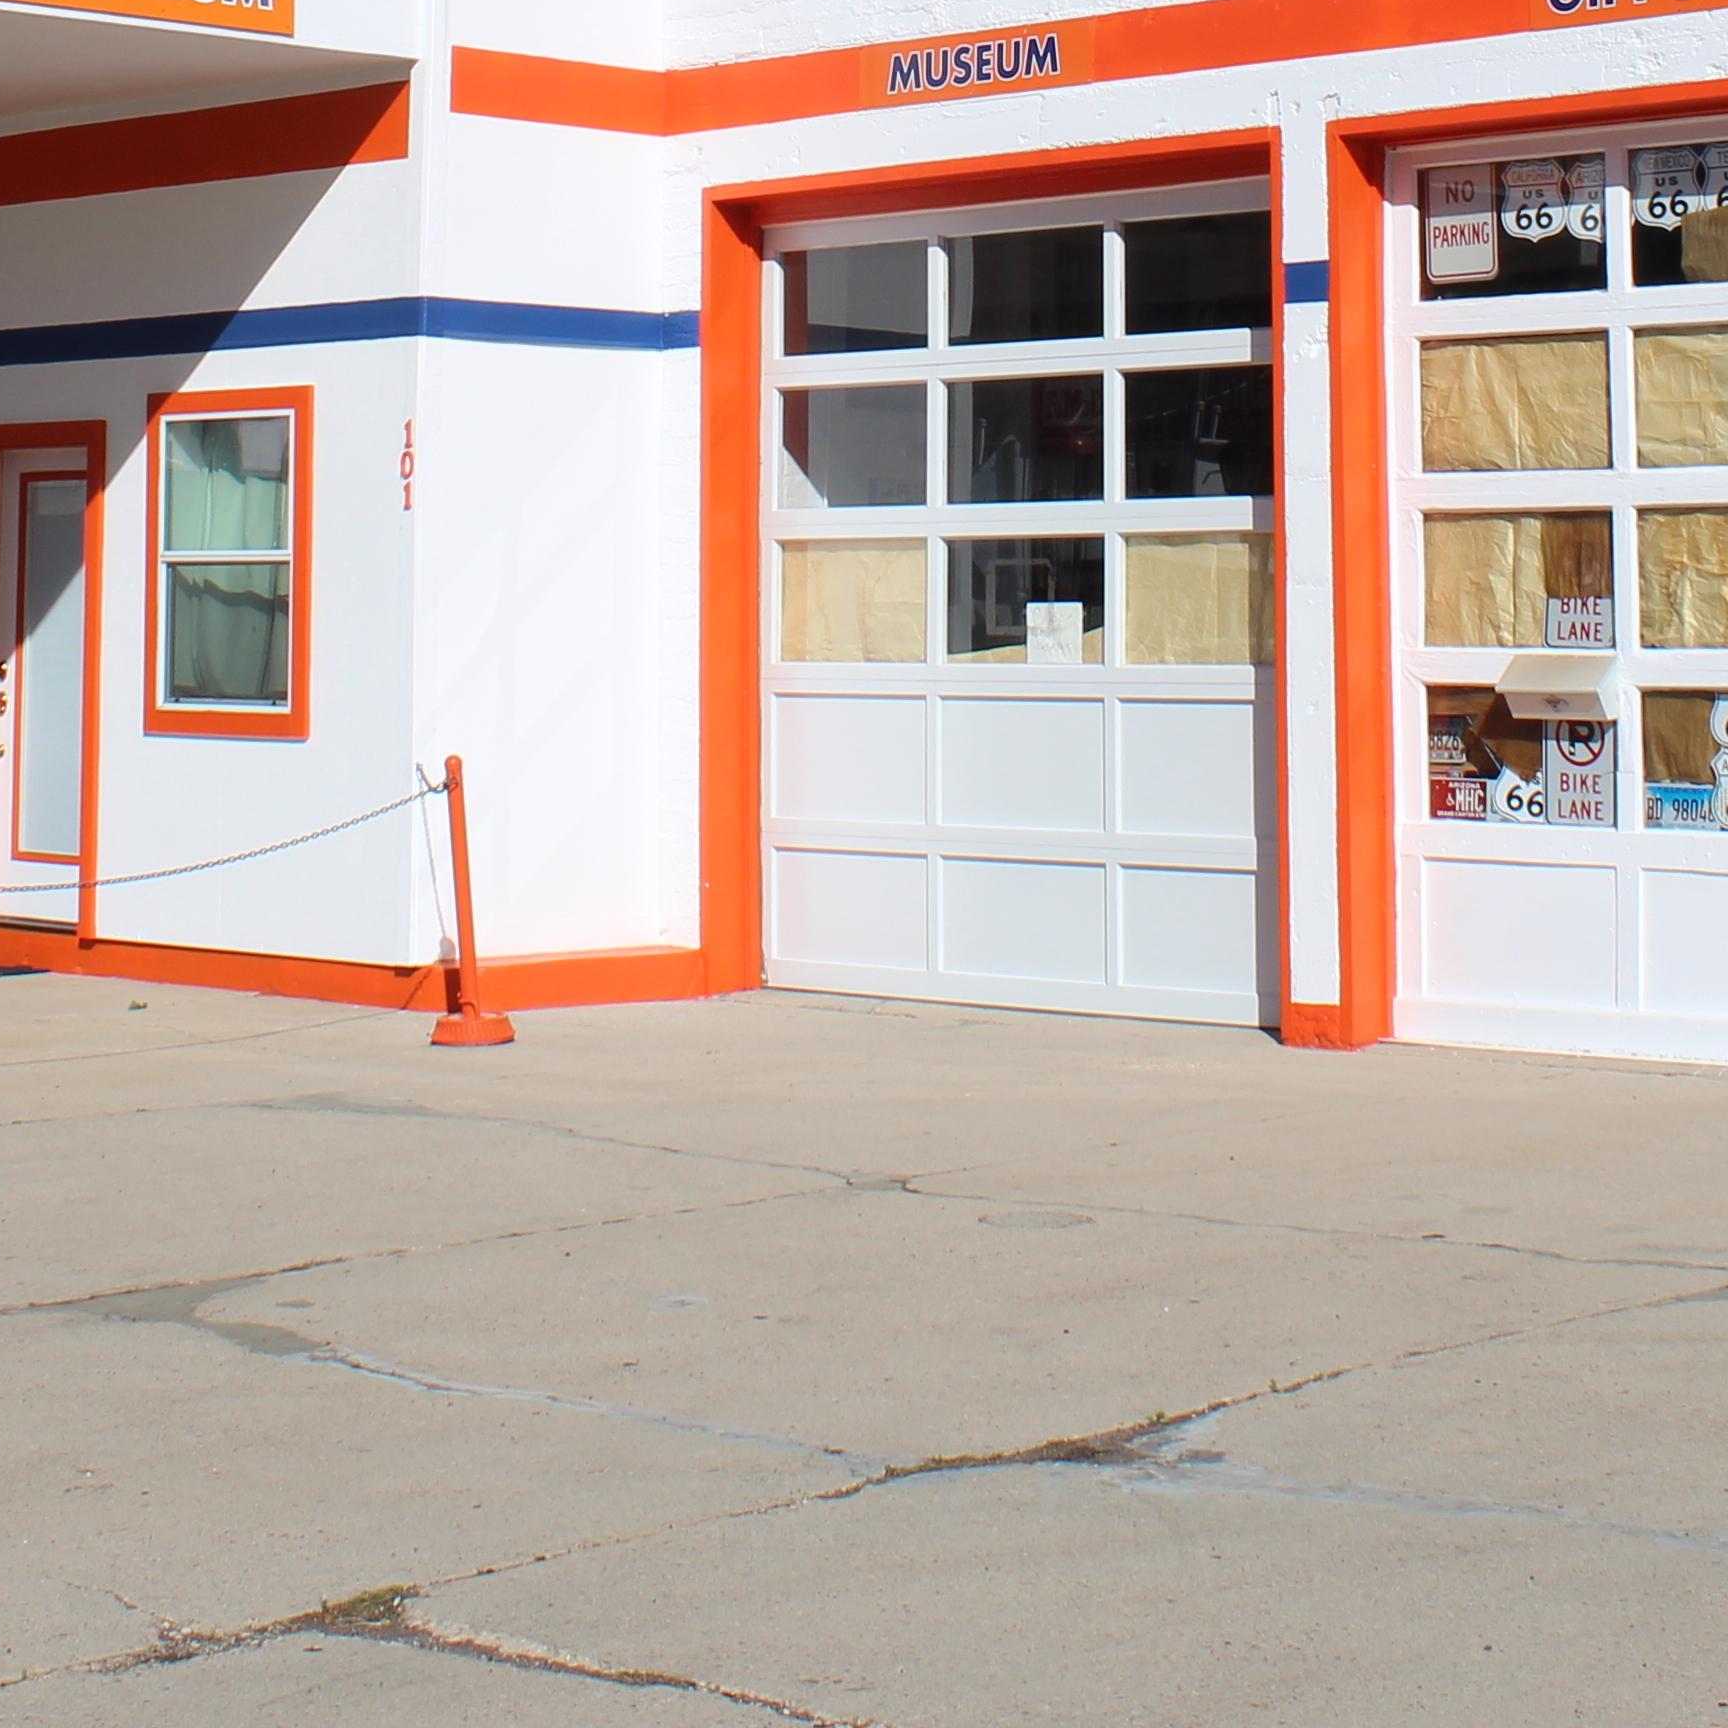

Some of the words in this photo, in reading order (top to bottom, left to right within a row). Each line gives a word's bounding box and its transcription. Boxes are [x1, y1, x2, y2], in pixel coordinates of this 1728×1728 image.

[885, 32, 1062, 96] MUSEUM
[1511, 167, 1555, 183] CALIFORNIA
[1654, 176, 1679, 187] US
[1444, 179, 1475, 204] NO
[1522, 189, 1545, 200] US
[1648, 188, 1689, 219] 66
[1515, 201, 1554, 231] 66
[1433, 221, 1490, 249] PARKING
[400, 418, 414, 511] 101
[1560, 597, 1602, 615] BIKE
[1557, 622, 1604, 642] LANE
[1560, 773, 1602, 794] BIKE
[1455, 788, 1485, 812] MHC
[1507, 785, 1544, 818] 66
[1557, 799, 1604, 821] LANE
